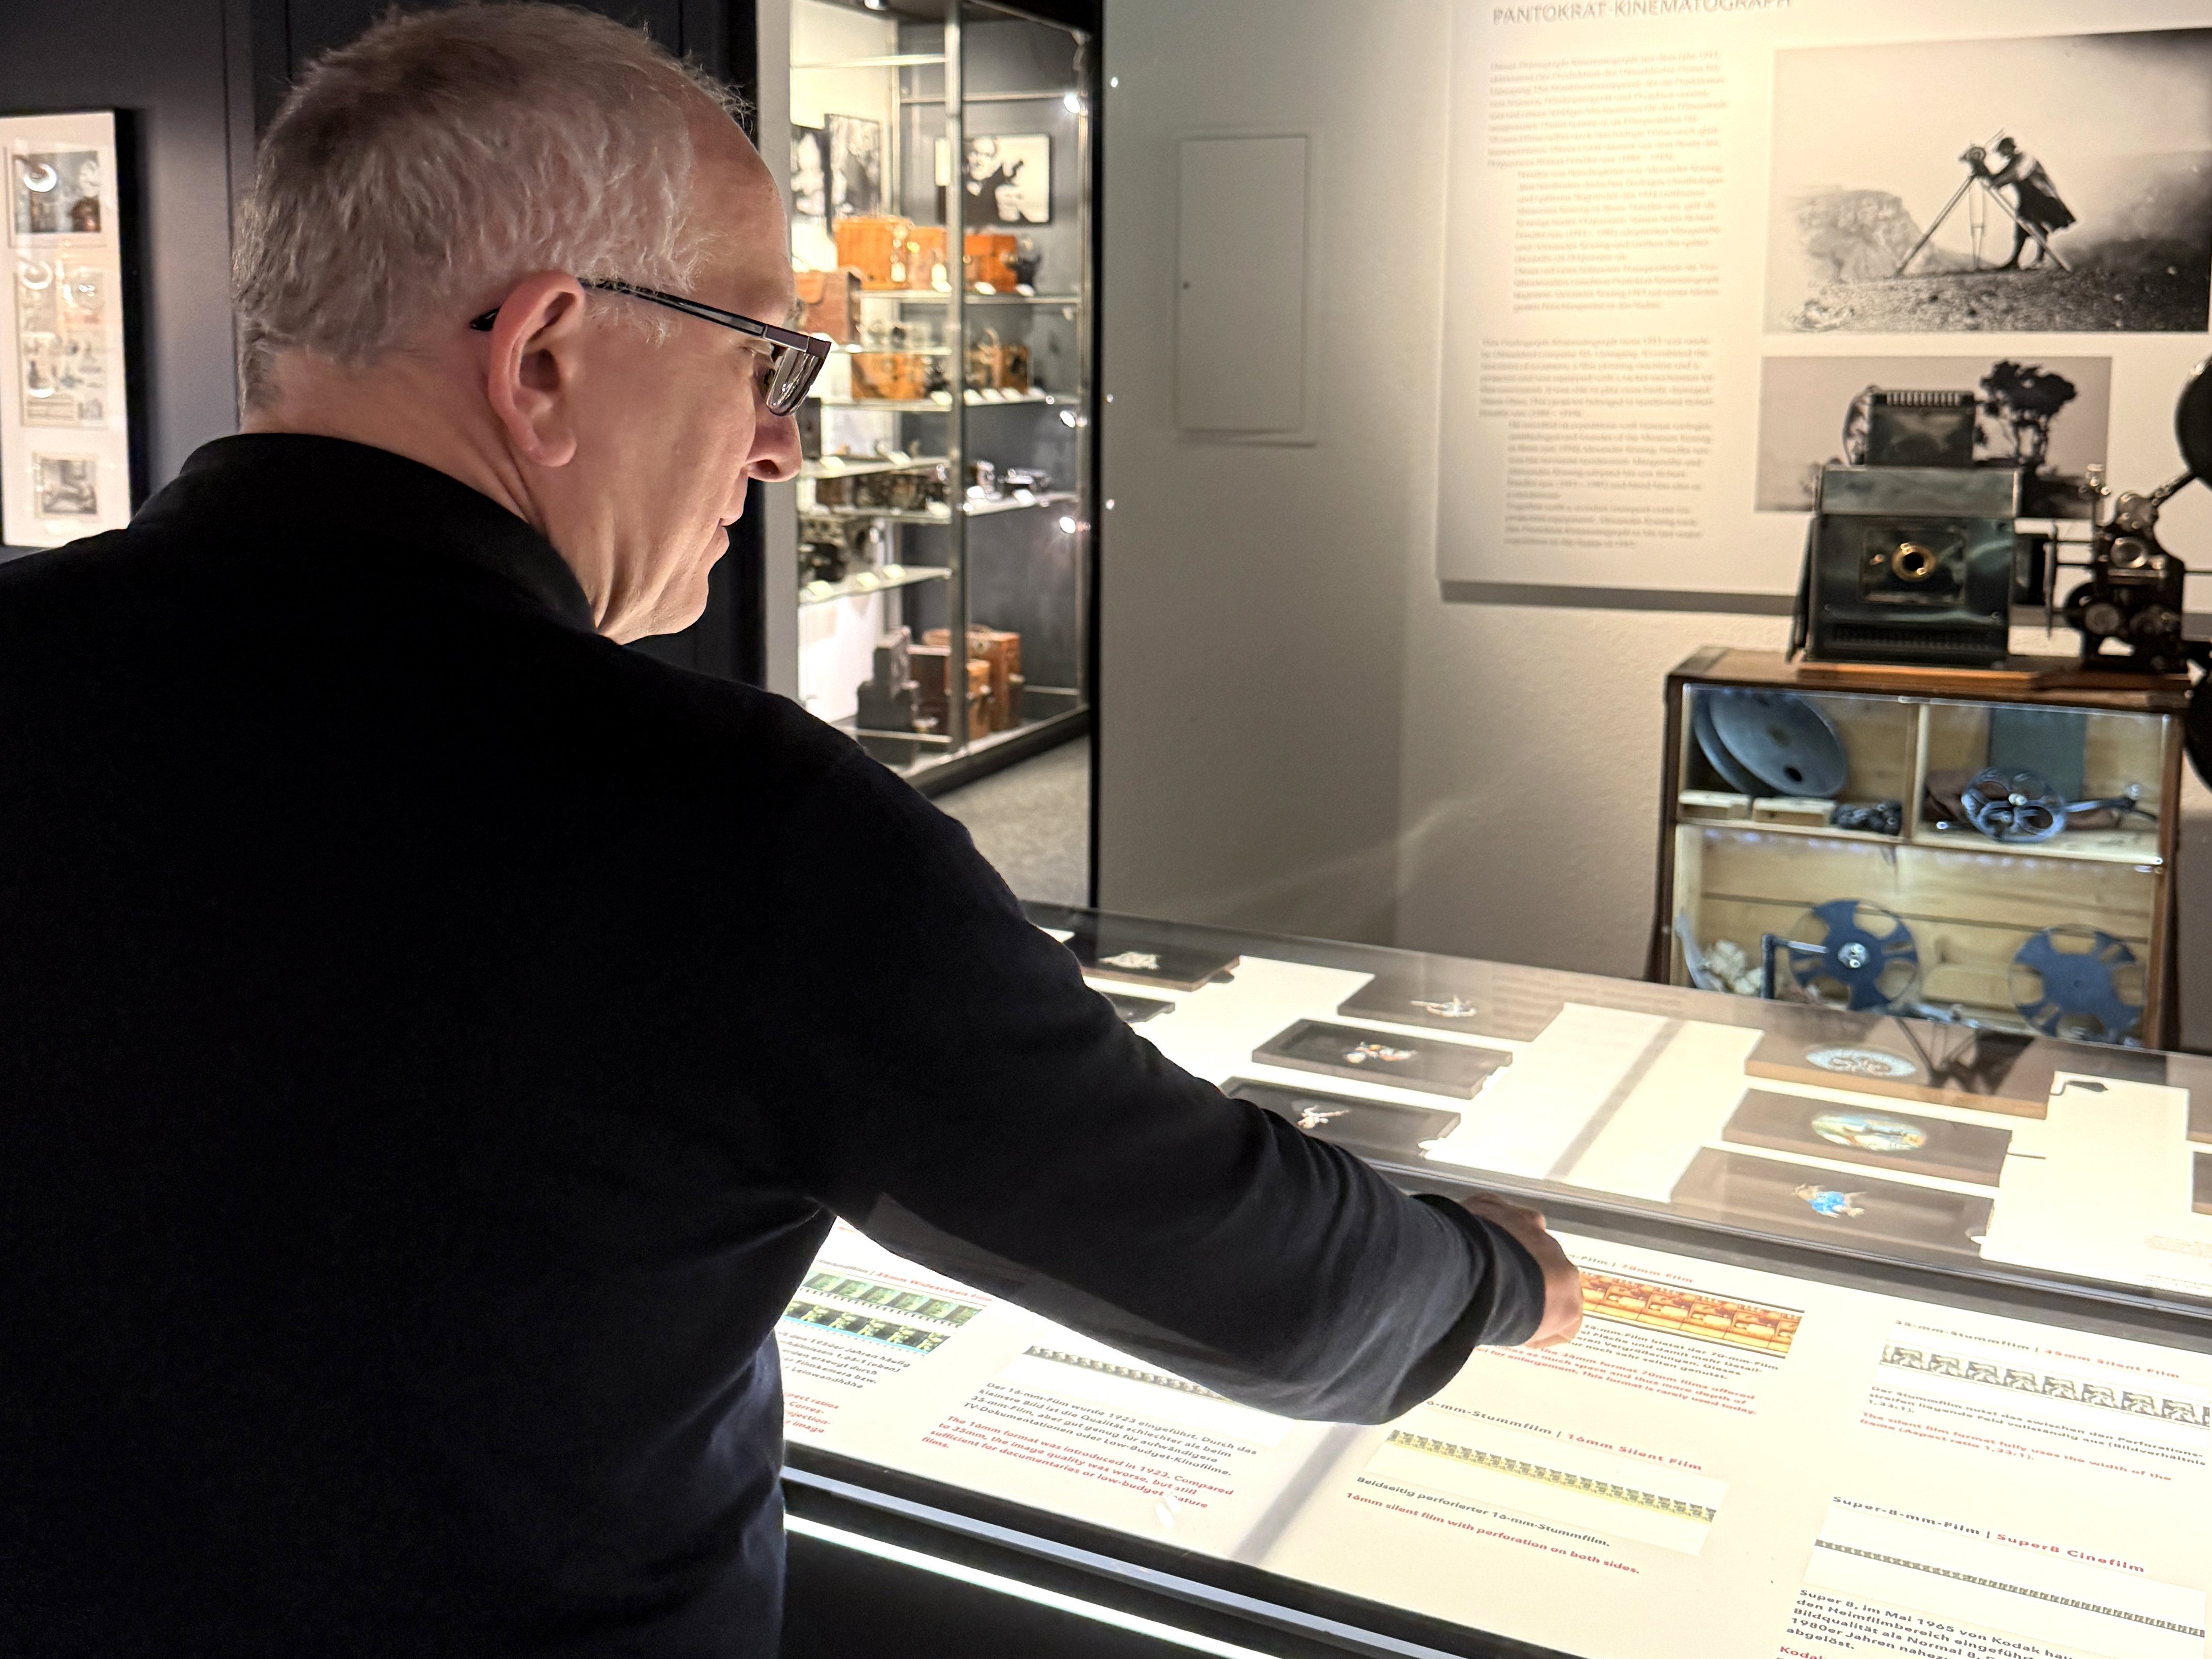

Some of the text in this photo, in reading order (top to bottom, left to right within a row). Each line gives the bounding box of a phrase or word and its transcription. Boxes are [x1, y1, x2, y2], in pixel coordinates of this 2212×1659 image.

[1586, 1345, 1613, 1354] noch
[1642, 1358, 1677, 1368] selten
[1692, 1355, 1721, 1364] mehr
[1703, 1364, 1741, 1375] Dieses
[2097, 1359, 2141, 1371] Silent
[1583, 1371, 1603, 1379] This
[1606, 1377, 1642, 1388] format
[1656, 1389, 1688, 1399] rarely
[1692, 1397, 1719, 1406] used
[1600, 1361, 1637, 1373] format
[1681, 1380, 1708, 1389] films
[1712, 1388, 1755, 1399] offered
[1635, 1377, 1658, 1385] thus
[1662, 1383, 1692, 1393] more
[1695, 1391, 1730, 1401] depth
[964, 1402, 1073, 1434] TV-Dokumentationen
[1076, 1433, 1102, 1441] oder
[979, 1389, 1020, 1402] kleinere
[1023, 1401, 1045, 1410] Bild
[1081, 1415, 1124, 1429] Qualität
[1126, 1428, 1183, 1444] schlechter
[1203, 1446, 1231, 1457] beim
[1037, 1414, 1064, 1425] aber
[1084, 1425, 1119, 1438] genug
[1071, 1405, 1105, 1415] wurde
[1109, 1413, 1136, 1423] 1923
[1138, 1422, 1197, 1440] eingeführt.
[1202, 1437, 1234, 1449] Durch
[1424, 1399, 1701, 1470] 6-mm-Stummfilm 16mm Silent Film
[1860, 1419, 1895, 1430] frame
[1864, 1412, 1884, 1420] The
[1888, 1419, 1921, 1429] silent
[1925, 1426, 1949, 1434] film
[1953, 1432, 1996, 1444] format
[2031, 1449, 2060, 1458] uses
[2089, 1461, 2127, 1472] width
[930, 1431, 981, 1447] sufficient
[979, 1443, 999, 1452] for
[998, 1448, 1080, 1473] documentaries
[1097, 1474, 1164, 1496] low-budget
[991, 1437, 1010, 1446] the
[1010, 1442, 1045, 1454] image
[1047, 1452, 1085, 1465] quality
[1088, 1463, 1109, 1472] was
[1152, 1479, 1174, 1489] but
[1003, 1430, 1039, 1443] format
[1041, 1441, 1063, 1450] was
[1064, 1446, 1125, 1467] introduced
[1175, 1476, 1234, 1495] Compared
[1357, 1477, 1609, 1546] Beidseitig perforierter 16-mm-Stummfilm.
[1833, 1497, 1979, 1535] Super-8-mm-Film
[1997, 1534, 2059, 1553] Super8
[1348, 1493, 1382, 1506] 16mm
[1385, 1504, 1418, 1515] silent
[1421, 1512, 1444, 1523] film
[1448, 1520, 1476, 1533] with
[1476, 1528, 1547, 1550] perforation
[1570, 1551, 1600, 1563] both
[1603, 1561, 1639, 1574] sides.
[1787, 1629, 1854, 1649] abgelöst.
[1792, 1618, 1894, 1649] 1980er Jahren
[1794, 1608, 1878, 1634] Bildqualität
[1907, 1636, 1962, 1655] Normal
[1797, 1600, 1949, 1641] den Heimfilmbereich
[1800, 1590, 2040, 1654] Super im Mai 1965 von Kodak
